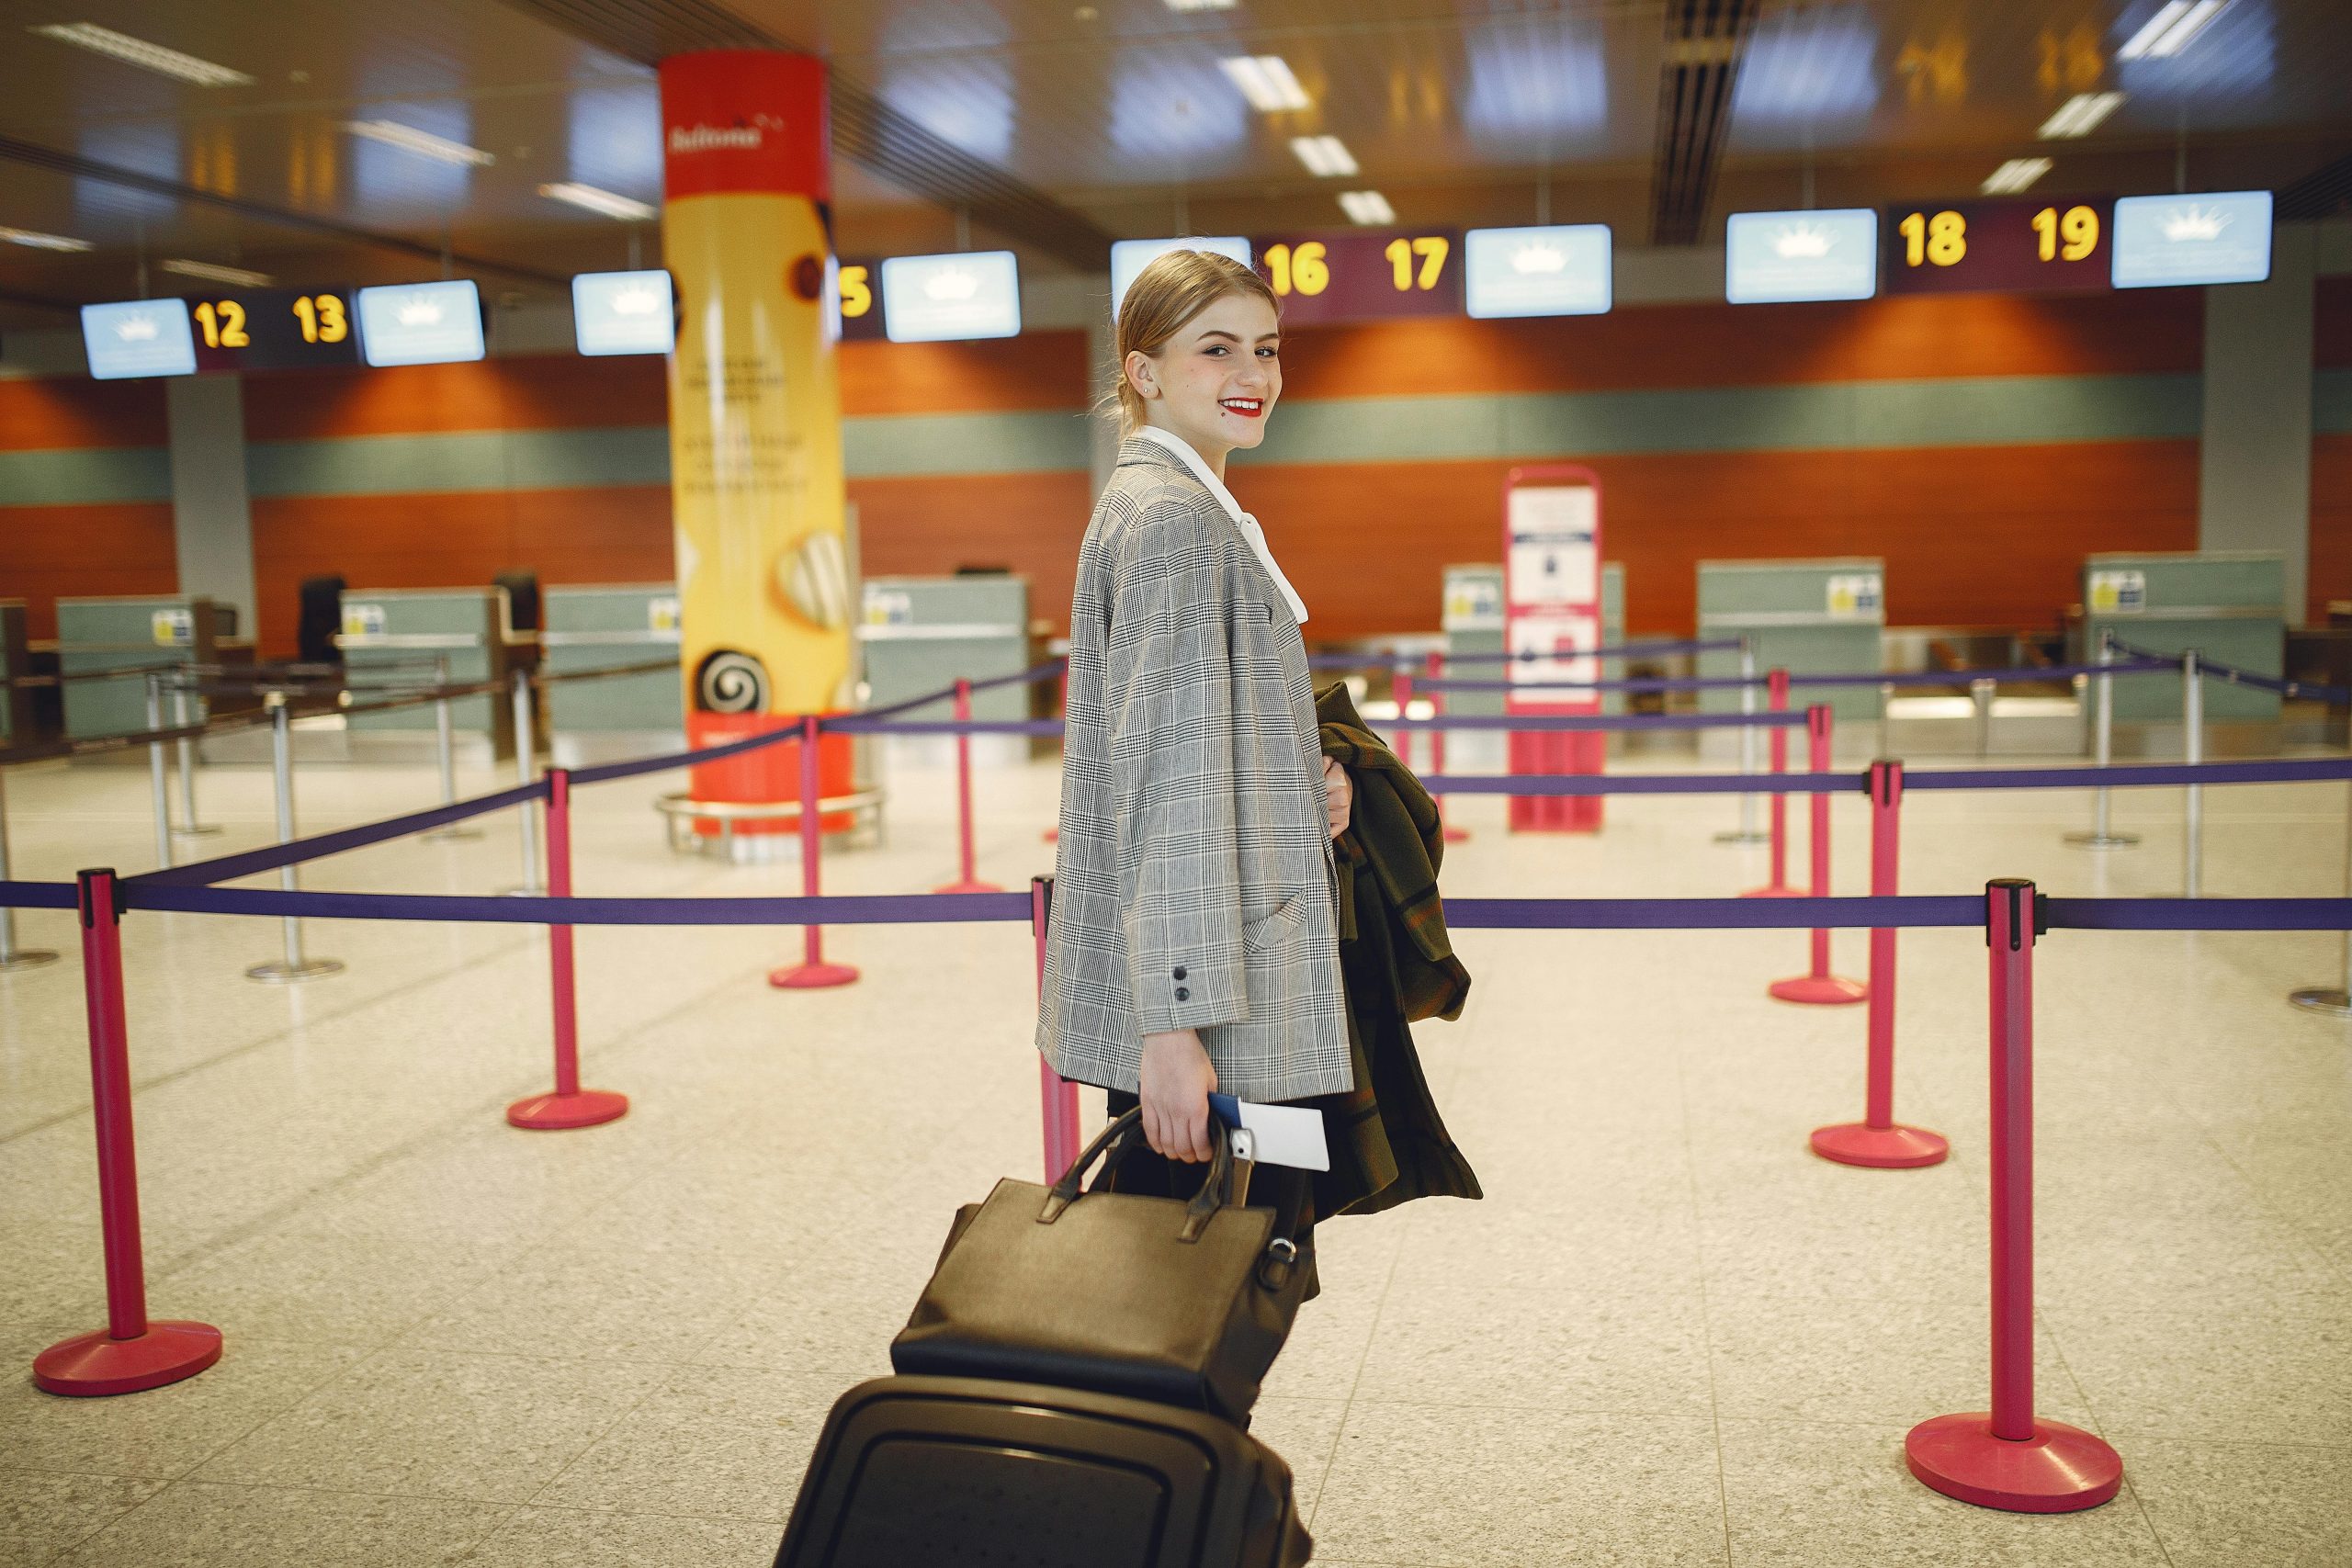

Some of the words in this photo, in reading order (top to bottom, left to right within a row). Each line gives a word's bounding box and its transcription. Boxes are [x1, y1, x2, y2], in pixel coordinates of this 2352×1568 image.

[1900, 210, 1967, 266] 18
[2032, 206, 2099, 262] 19
[838, 265, 872, 318] 5
[1263, 241, 1330, 298] 16
[1385, 236, 1450, 292] 17
[195, 299, 250, 348] 12
[293, 294, 348, 344] 13
